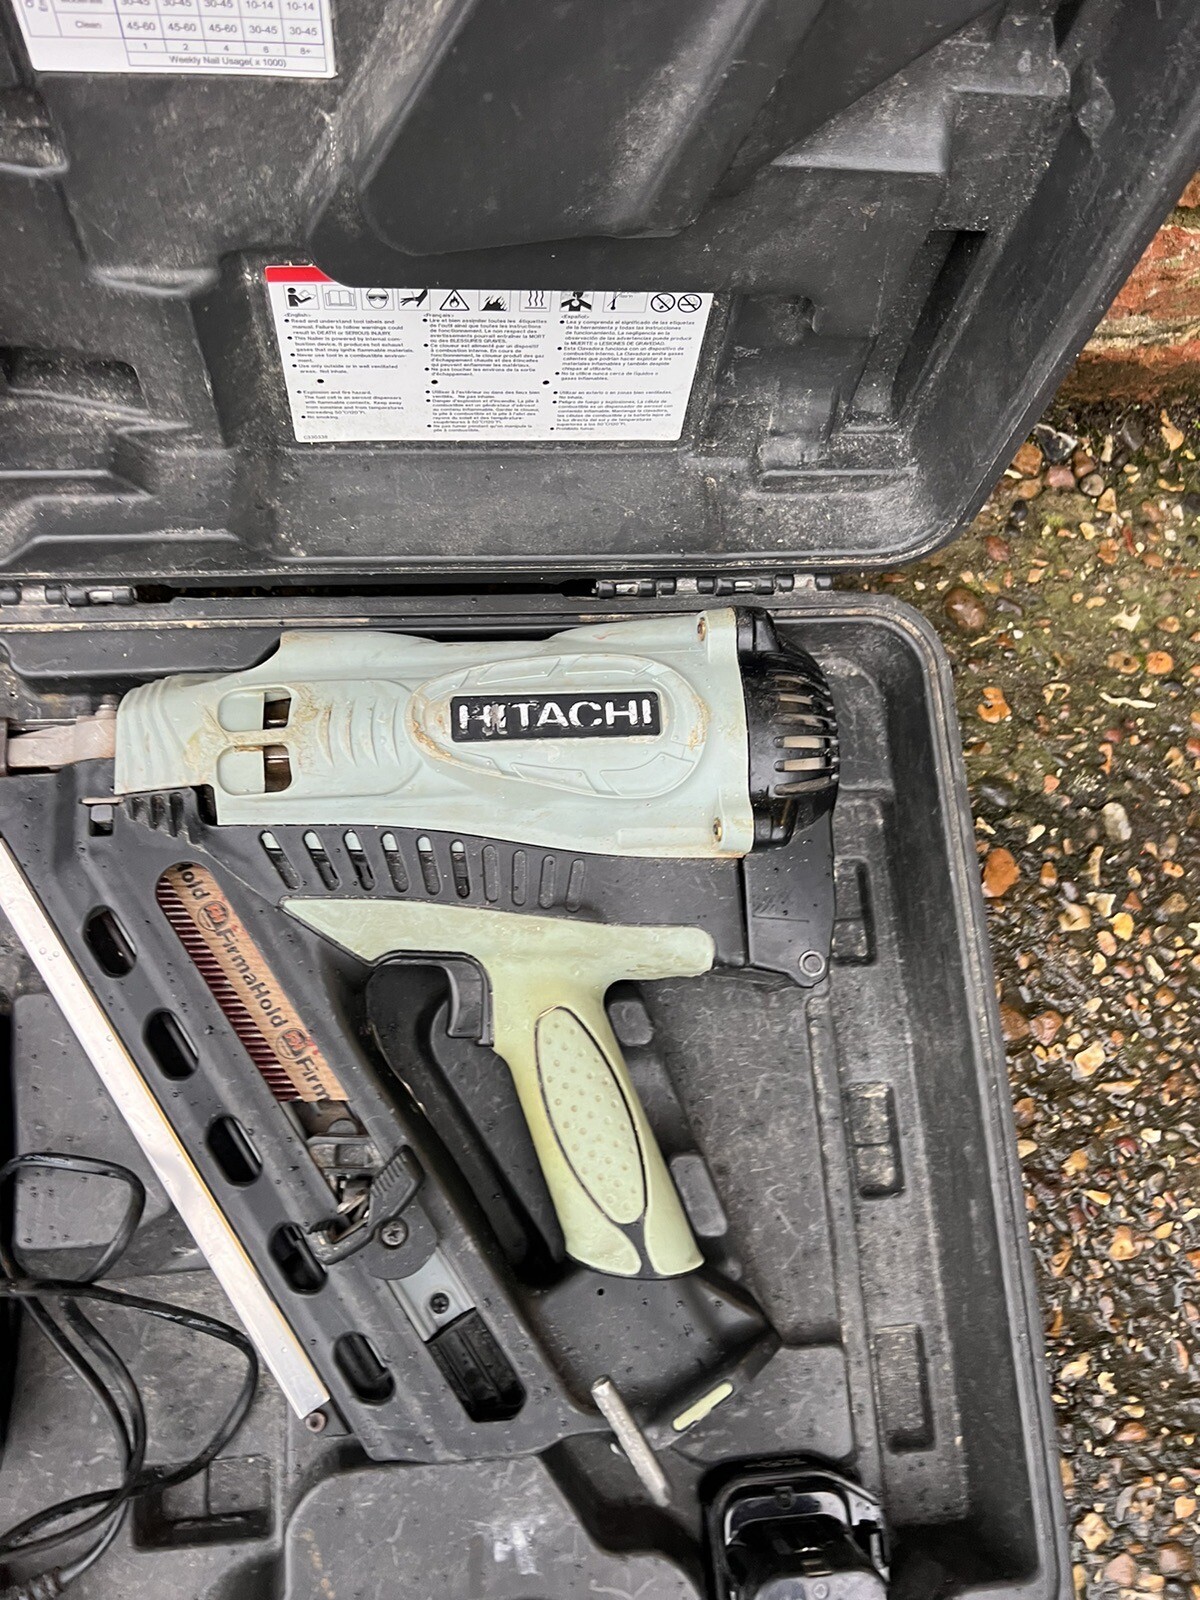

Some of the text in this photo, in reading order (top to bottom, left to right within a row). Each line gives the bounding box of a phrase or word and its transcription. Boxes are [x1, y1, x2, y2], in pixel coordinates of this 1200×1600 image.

[204, 0, 234, 8] 30-45
[246, 0, 274, 9] 10-14
[287, 2, 314, 11] 10-14
[127, 22, 156, 31] 45-60
[168, 23, 197, 32] 45-60
[209, 24, 238, 33] 45-60
[249, 25, 278, 35] 30-45
[289, 26, 318, 36] 30-45
[183, 43, 189, 51] 2
[300, 47, 312, 55] 8+
[169, 55, 201, 66] Weekly
[459, 699, 652, 731] HITACHI
[216, 928, 288, 1028] FirmaHold
